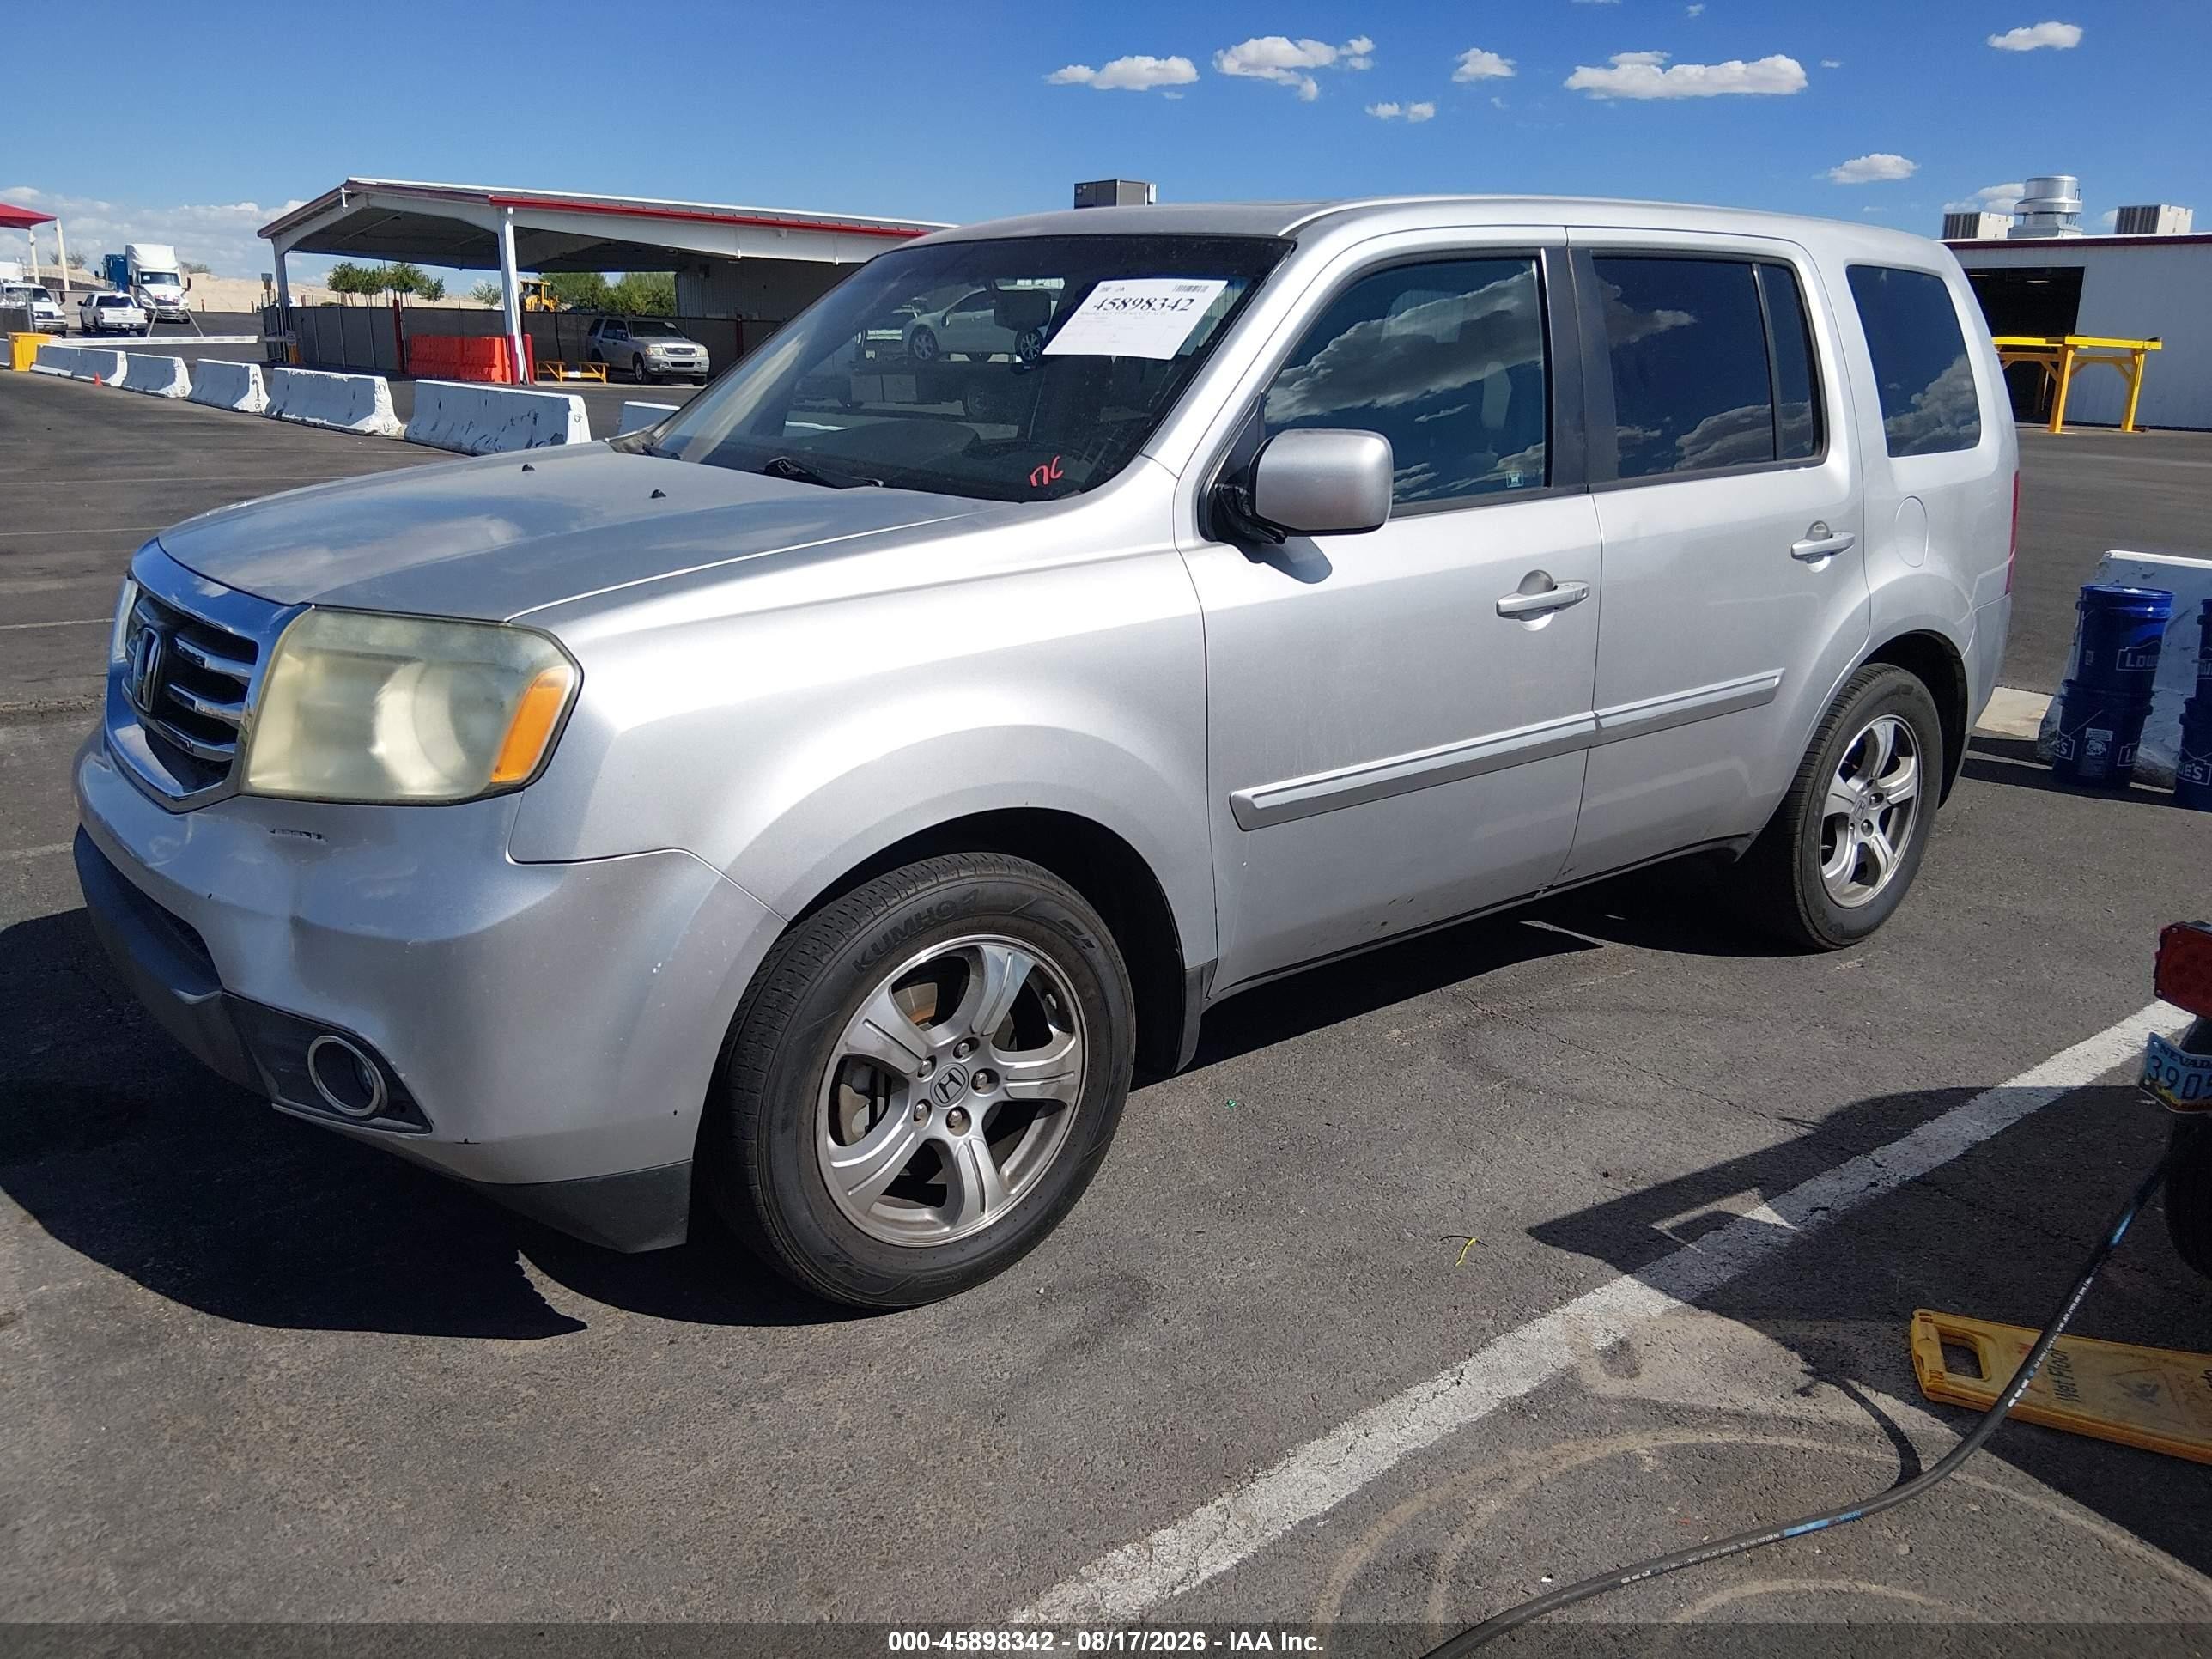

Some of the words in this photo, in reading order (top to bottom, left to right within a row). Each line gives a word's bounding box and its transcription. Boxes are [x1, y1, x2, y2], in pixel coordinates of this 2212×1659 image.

[1092, 297, 1195, 311] 45898342
[851, 900, 957, 974] KUMHO
[2160, 1044, 2212, 1069] NEVAD
[2047, 1348, 2074, 1380] Floor
[2052, 1380, 2082, 1402] Wet
